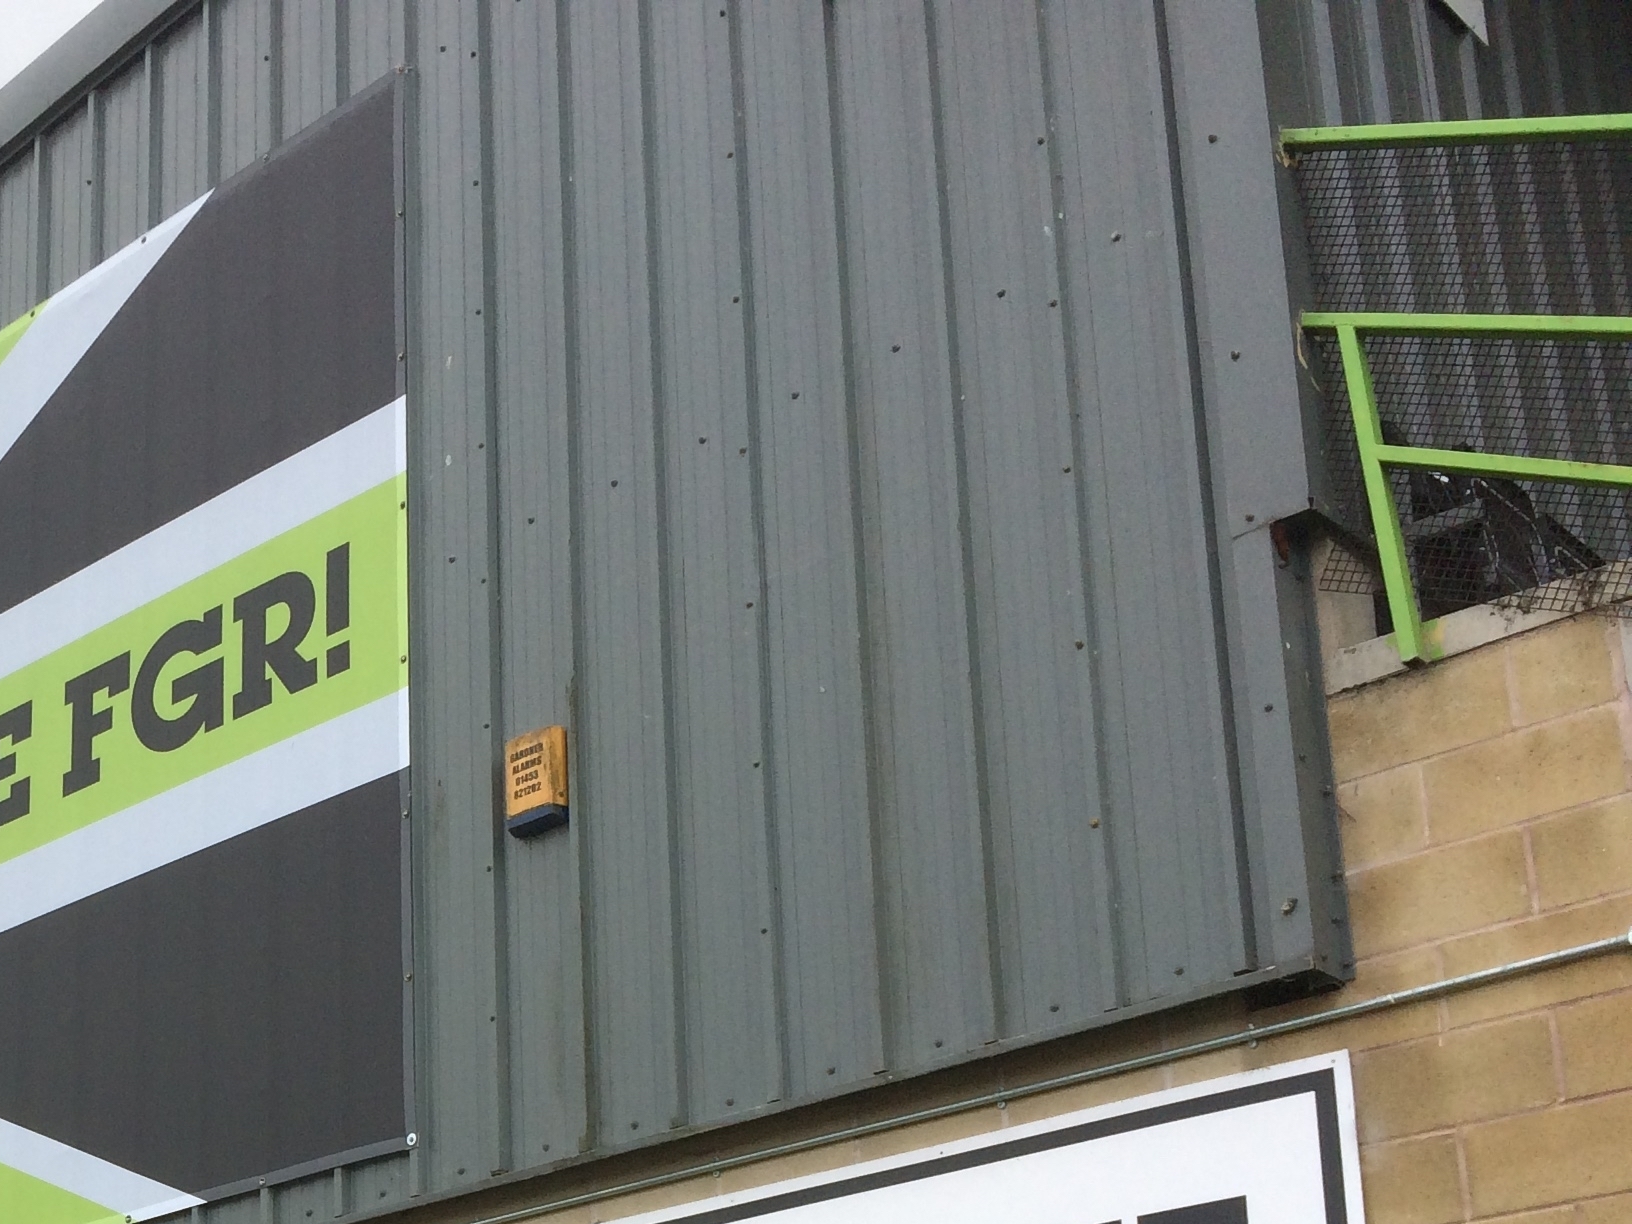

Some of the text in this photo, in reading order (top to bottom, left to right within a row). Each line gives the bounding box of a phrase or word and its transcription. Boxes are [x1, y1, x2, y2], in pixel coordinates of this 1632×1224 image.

[62, 541, 351, 798] FGR!
[510, 743, 543, 763] GARDNER
[512, 756, 542, 775] ALARMS
[516, 770, 539, 786] 01453
